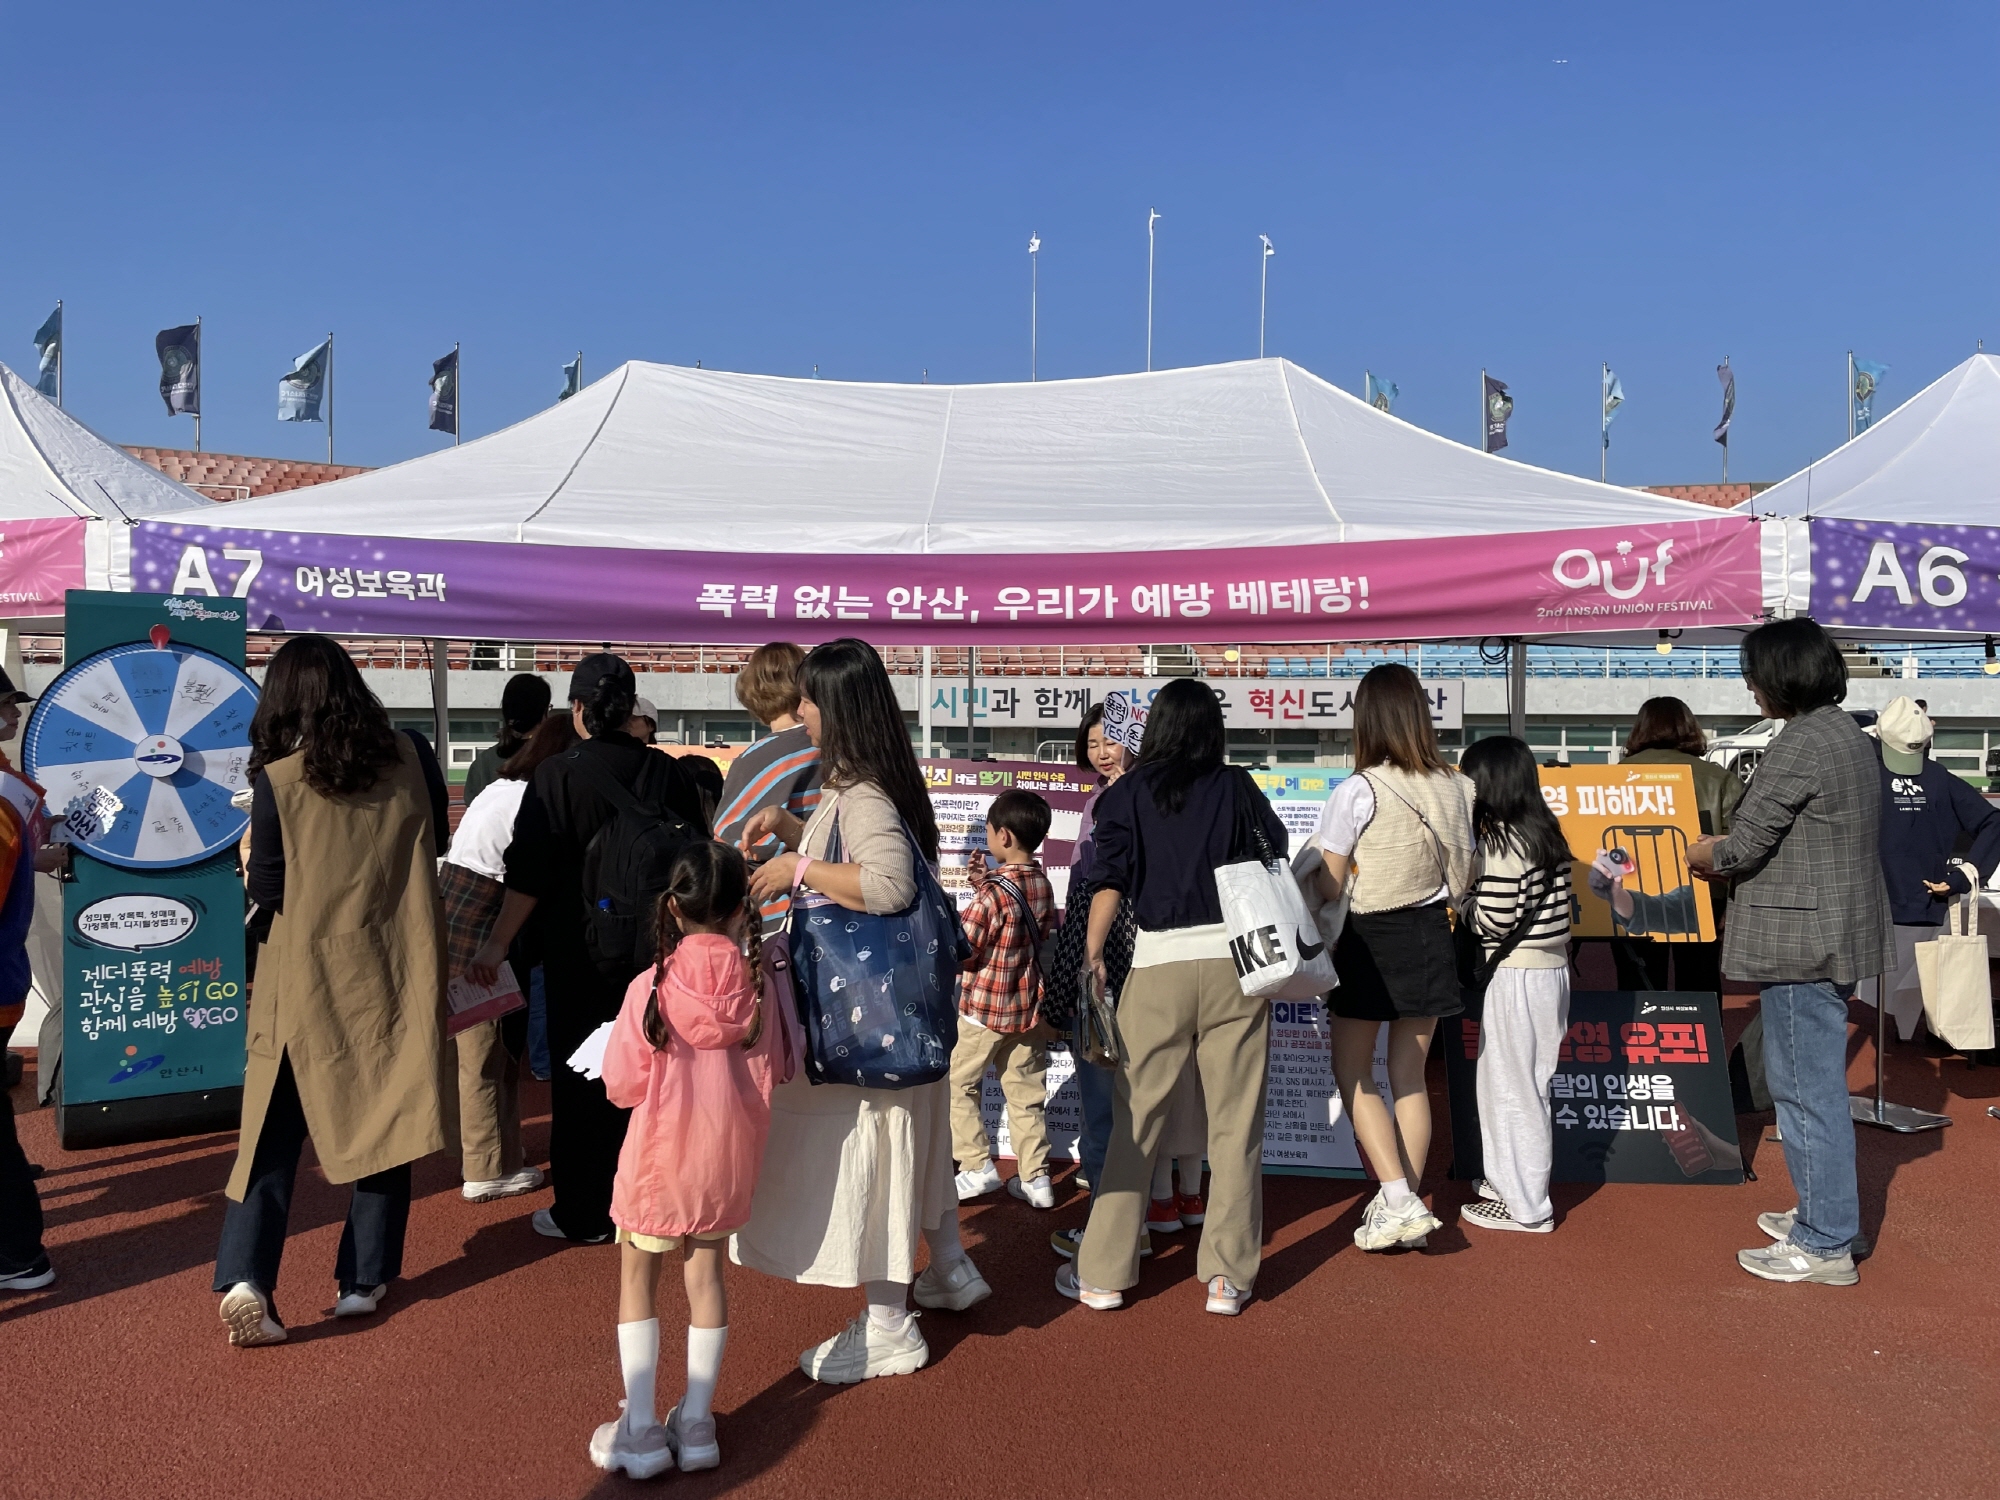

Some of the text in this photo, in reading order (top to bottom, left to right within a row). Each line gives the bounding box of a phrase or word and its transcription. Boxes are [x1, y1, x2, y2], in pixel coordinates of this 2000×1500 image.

[172, 546, 446, 601] A7 여성보육과
[1851, 542, 1970, 607] A6
[696, 576, 1369, 623] 폭력 없는 안산, 우리가 예방 베테랑!
[1537, 599, 1714, 618] 2nd ANSAN UNION FESTIVAL
[931, 687, 1020, 718] 시민과
[1033, 687, 1092, 719] 함께
[1576, 785, 1676, 816] 피해자!
[65, 809, 97, 841] 안산
[179, 957, 223, 980] 예방
[80, 986, 147, 1015] 관심을
[81, 1014, 126, 1041] 함께
[132, 1010, 178, 1034] 예방
[1277, 1029, 1300, 1038] 정당한
[1620, 1022, 1710, 1064] 유포!
[1283, 1053, 1320, 1063] 찾아오거나
[1287, 1066, 1318, 1075] 보내거나
[1286, 1077, 1299, 1086] SNS
[1550, 1073, 1675, 1101] 람의 인생을
[985, 1102, 1002, 1112] 10대
[1584, 1105, 1687, 1132] 있습니다.
[1276, 1150, 1308, 1159] 여성보육과
